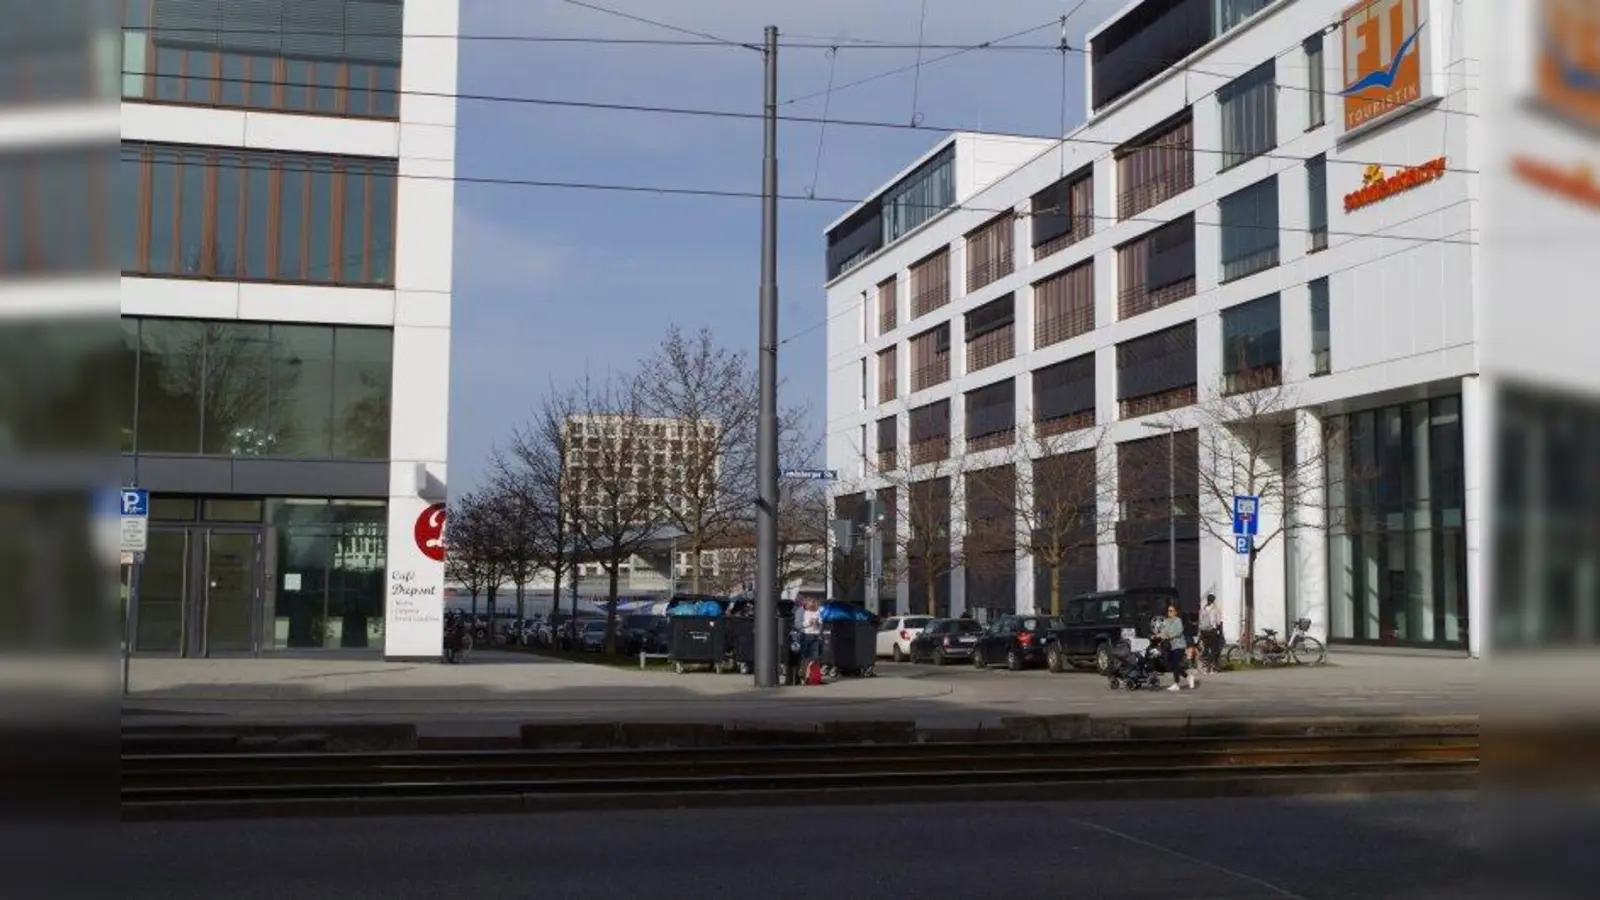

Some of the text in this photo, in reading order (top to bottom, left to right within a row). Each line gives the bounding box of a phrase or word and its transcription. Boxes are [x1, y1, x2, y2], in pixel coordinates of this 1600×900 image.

[1346, 0, 1416, 85] FTI
[1348, 83, 1418, 125] TOURISTIK
[123, 492, 140, 512] P
[1237, 538, 1246, 552] P
